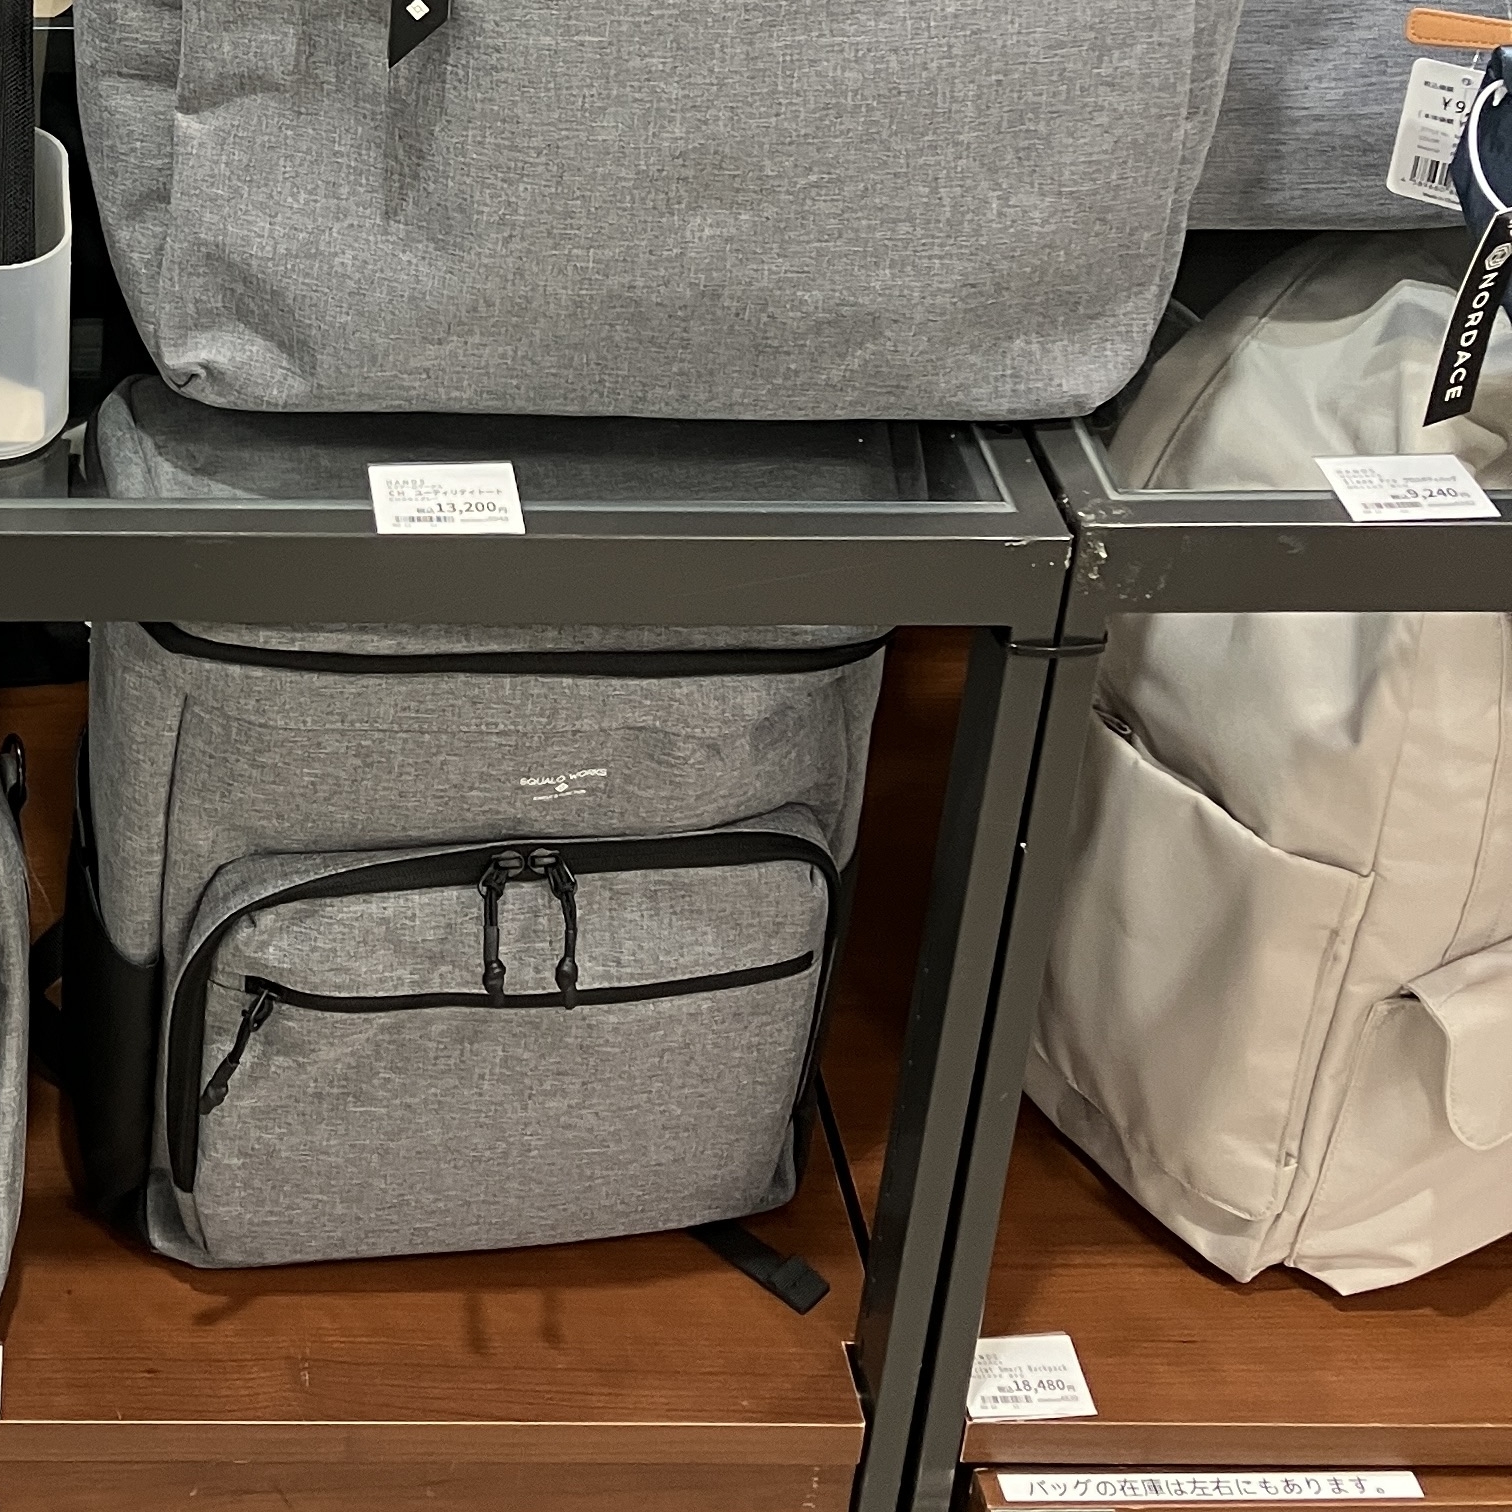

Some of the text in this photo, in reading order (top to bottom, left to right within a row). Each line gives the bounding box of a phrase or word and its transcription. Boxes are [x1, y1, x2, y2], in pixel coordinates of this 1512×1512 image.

[1444, 272, 1495, 402] NORDACE
[1028, 1476, 1387, 1498] バッグの在庫は左右にもあります。
